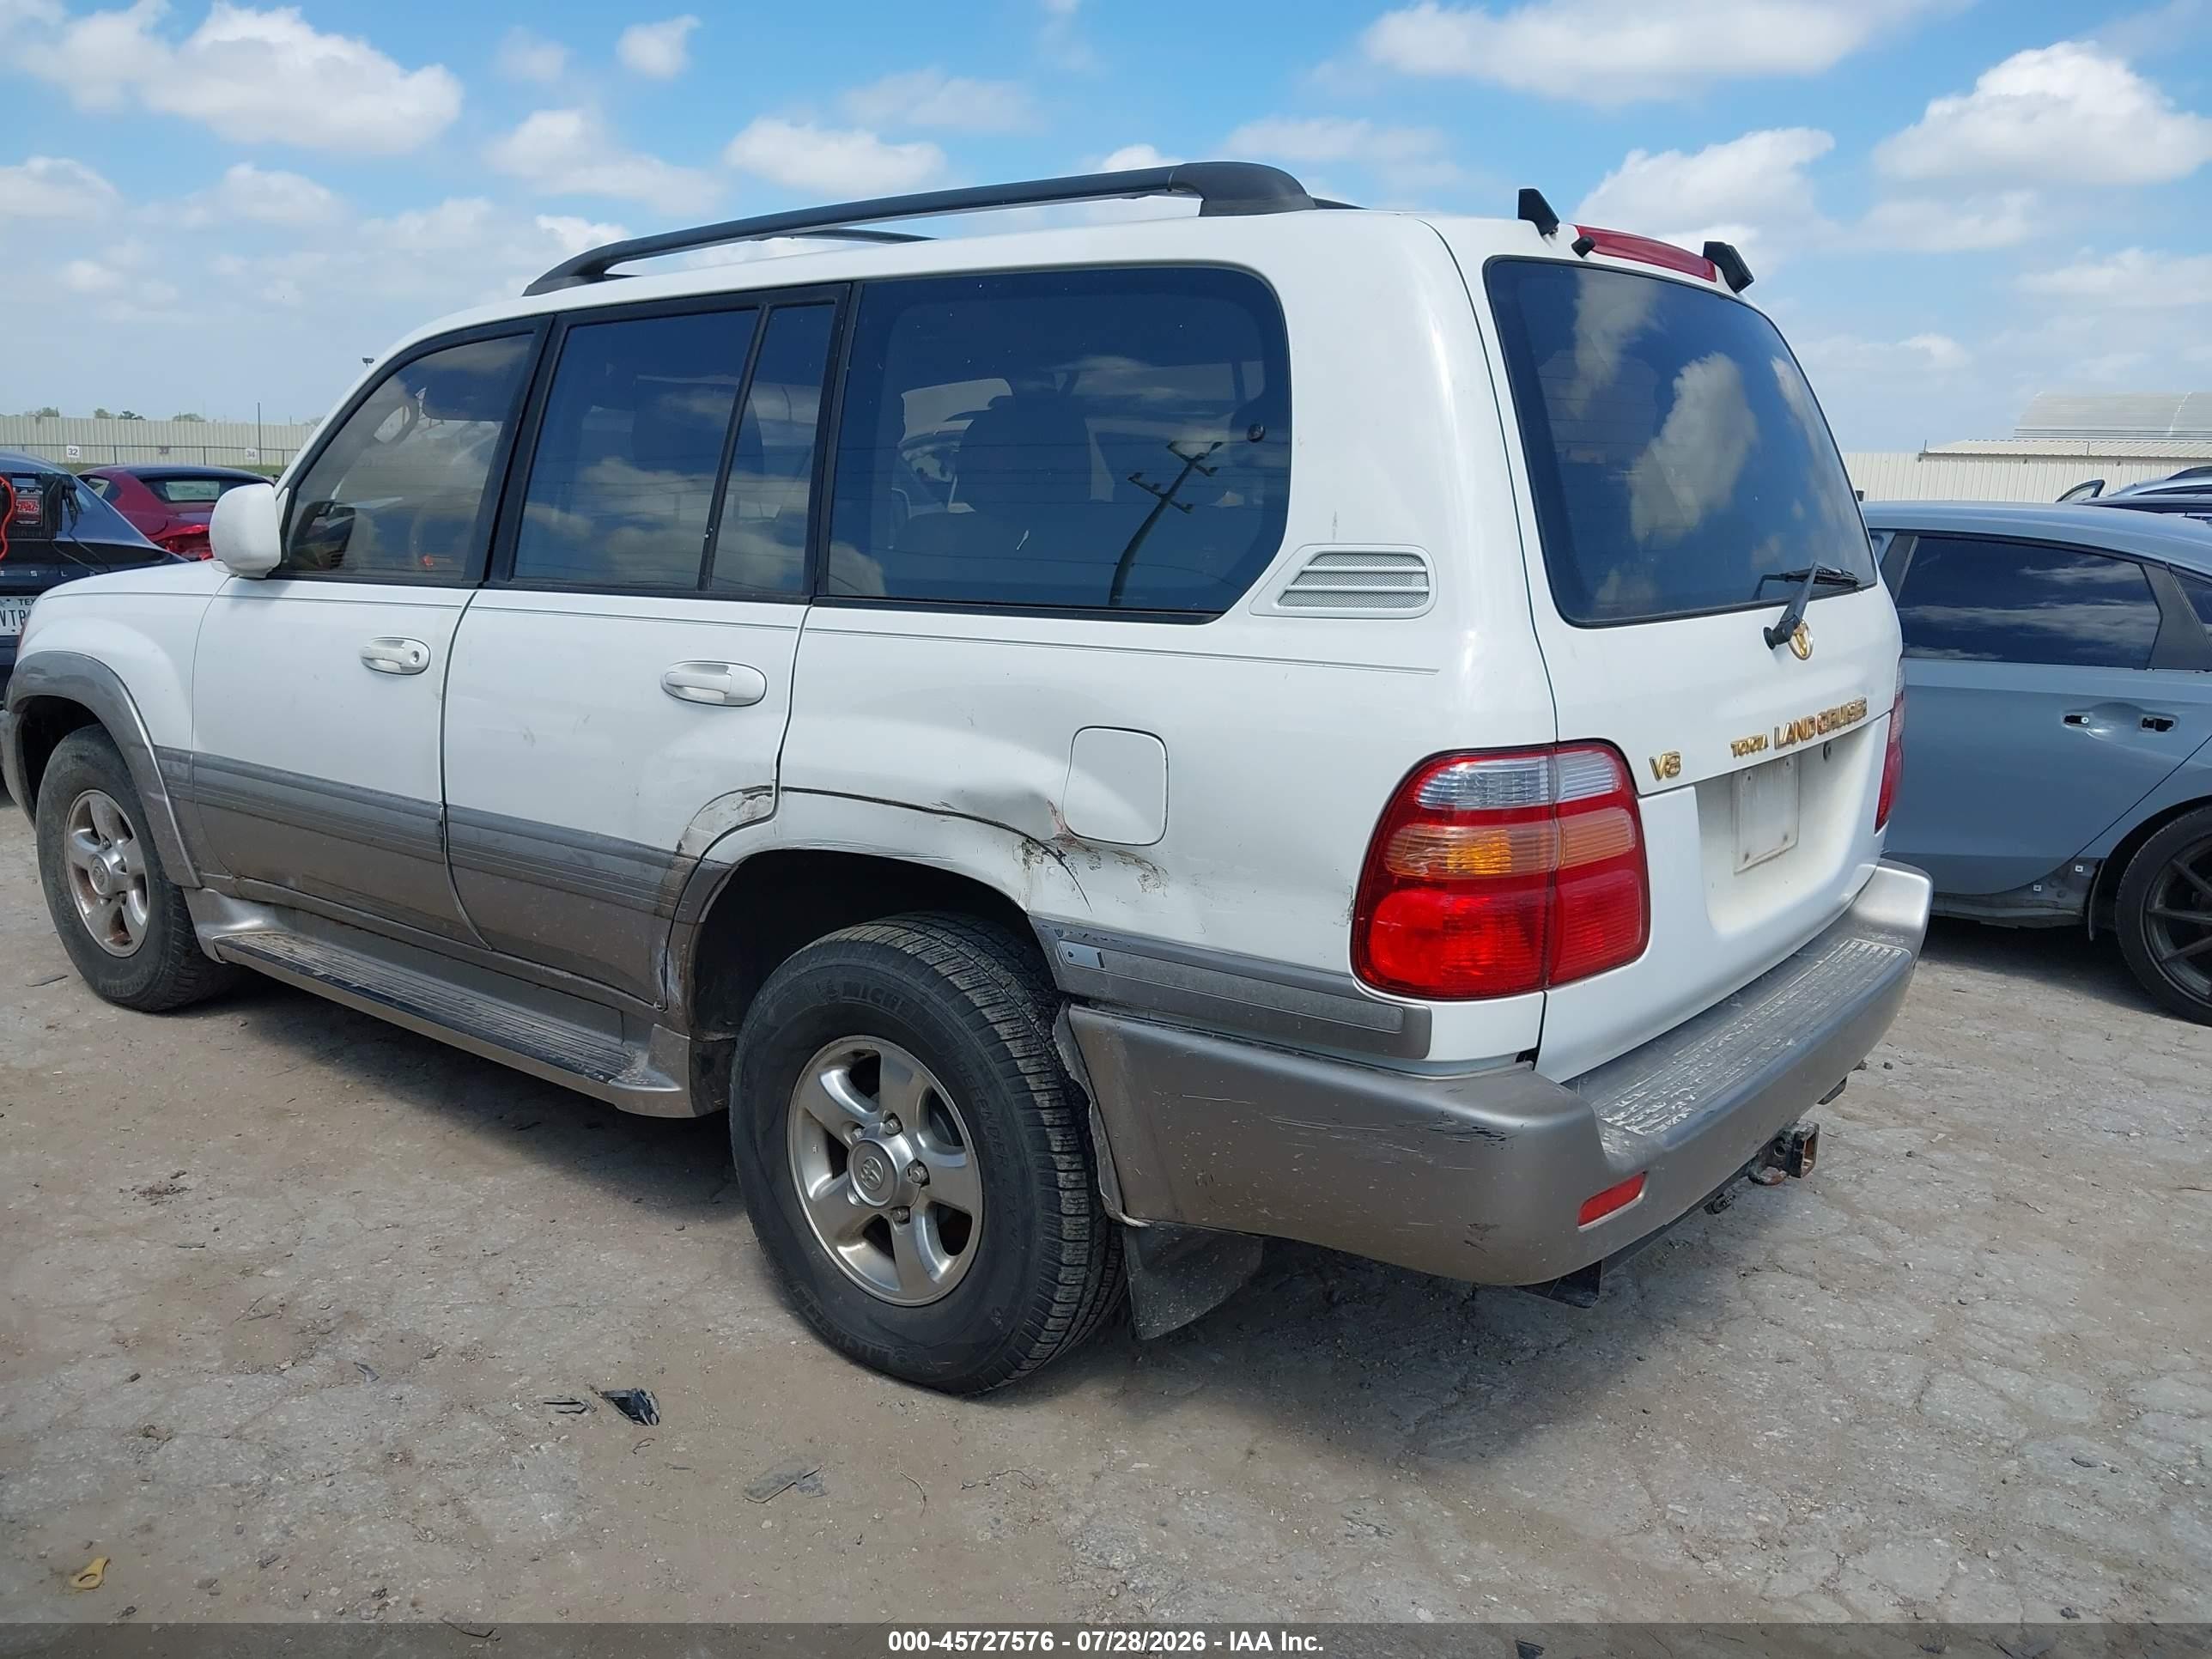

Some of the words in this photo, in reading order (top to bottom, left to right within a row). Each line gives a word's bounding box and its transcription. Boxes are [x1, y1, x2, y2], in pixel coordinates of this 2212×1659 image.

[68, 447, 78, 456] 32
[1774, 715, 1816, 750] LAND
[1817, 696, 1868, 735] CRUISER
[1648, 750, 1681, 781] V8
